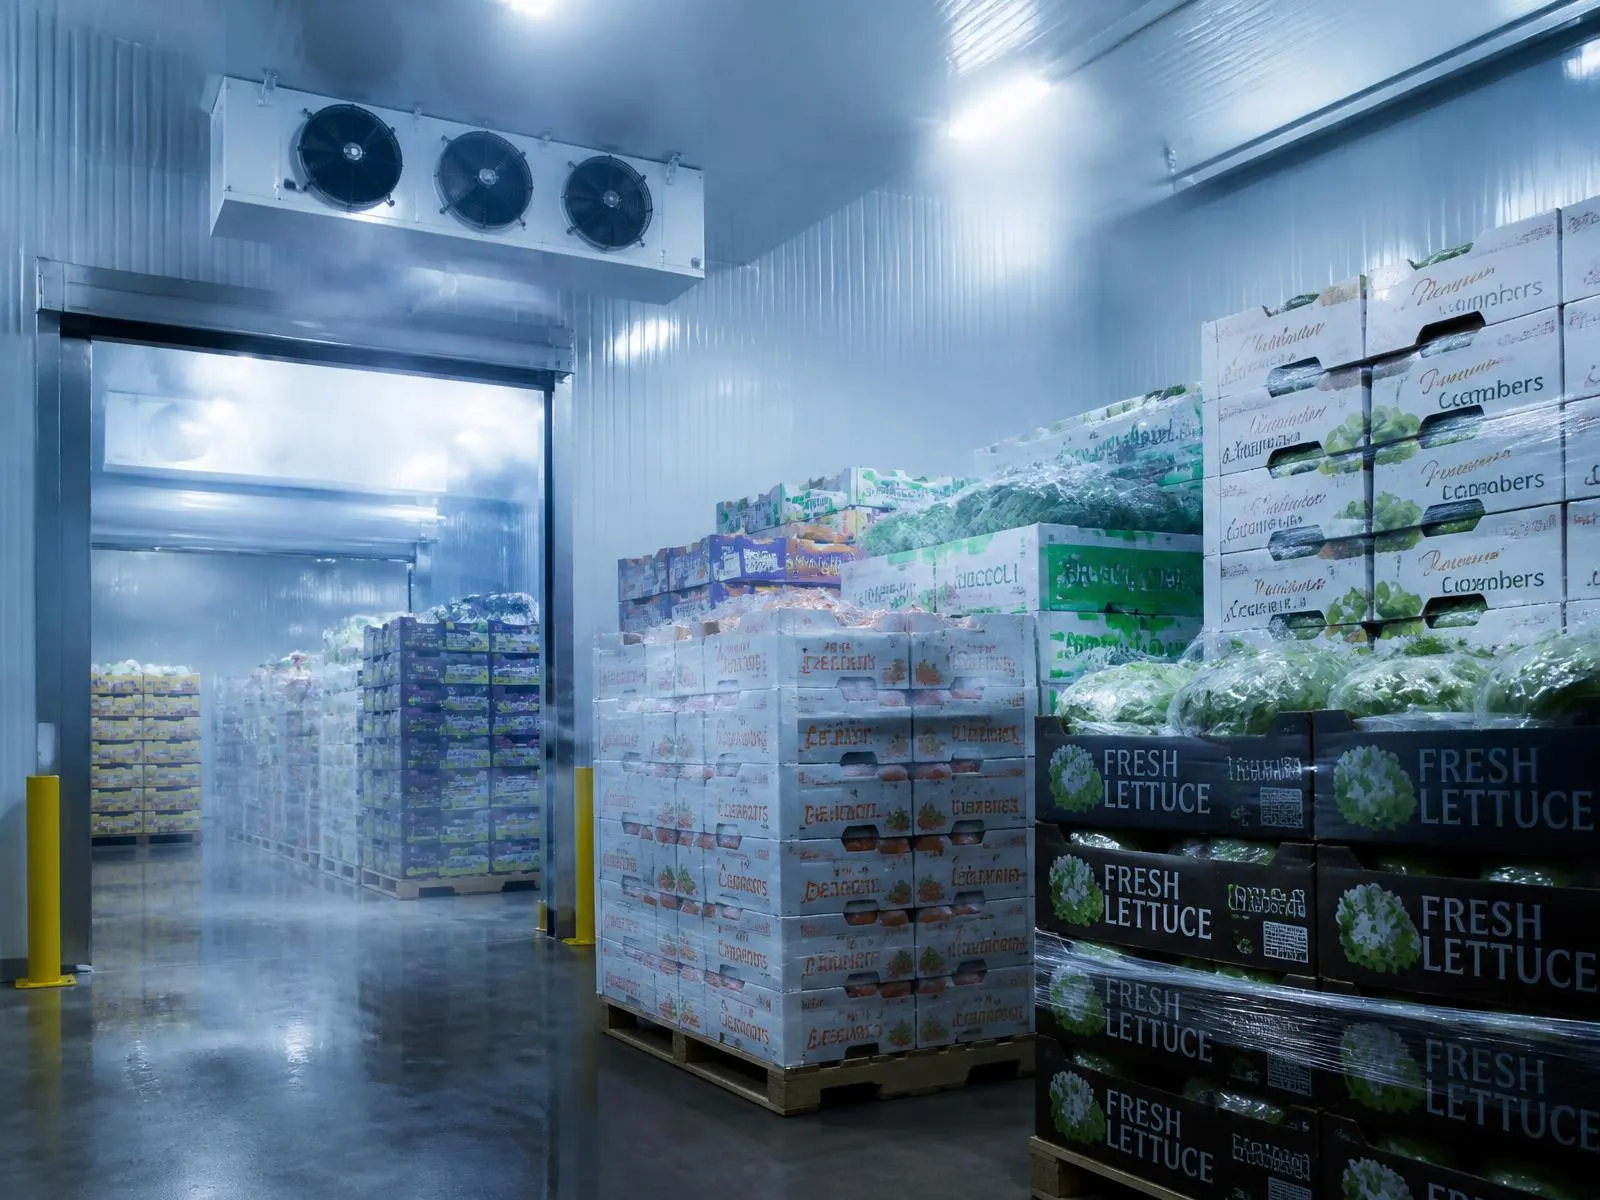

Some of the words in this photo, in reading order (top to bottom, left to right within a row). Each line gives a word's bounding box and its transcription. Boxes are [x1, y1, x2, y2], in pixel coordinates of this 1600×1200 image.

[1103, 748, 1178, 778] FRESH
[1418, 748, 1538, 784] FRESH
[1103, 779, 1211, 815] LETTUCE
[1419, 787, 1595, 831] LETTUCE
[1103, 864, 1179, 900] FRESH
[1104, 901, 1212, 940] LETTUCE
[1421, 895, 1542, 941] FRESH
[1421, 936, 1598, 993] LETTUCE
[1105, 976, 1180, 1020] FRESH
[1106, 1007, 1213, 1064] LETTUCE
[1425, 1038, 1545, 1095] FRESH
[1106, 1088, 1181, 1138] FRESH
[1425, 1078, 1600, 1154] LETTUCE
[1106, 1118, 1214, 1184] LETTUCE
